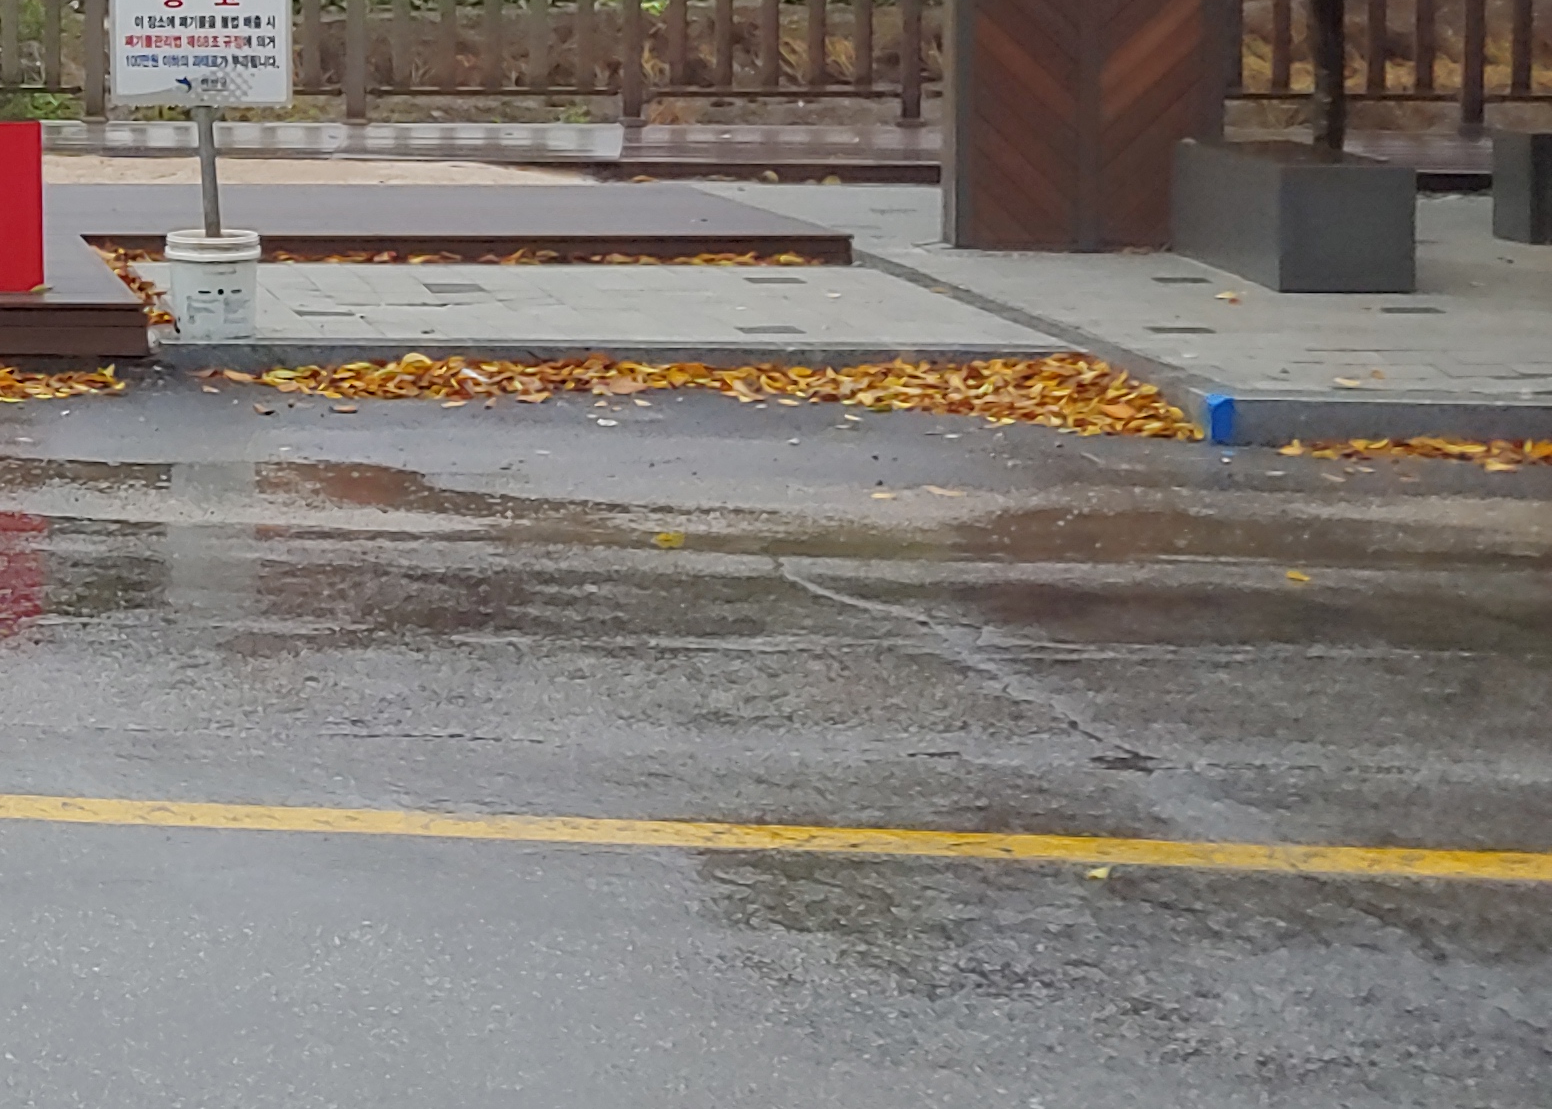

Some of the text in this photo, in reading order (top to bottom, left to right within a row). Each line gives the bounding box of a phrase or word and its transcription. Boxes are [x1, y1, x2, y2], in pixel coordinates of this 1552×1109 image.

[134, 15, 144, 29] 이
[147, 15, 175, 29] 장소에
[179, 15, 216, 29] 폐기물을
[221, 15, 239, 29] 불법
[266, 15, 276, 29] 시
